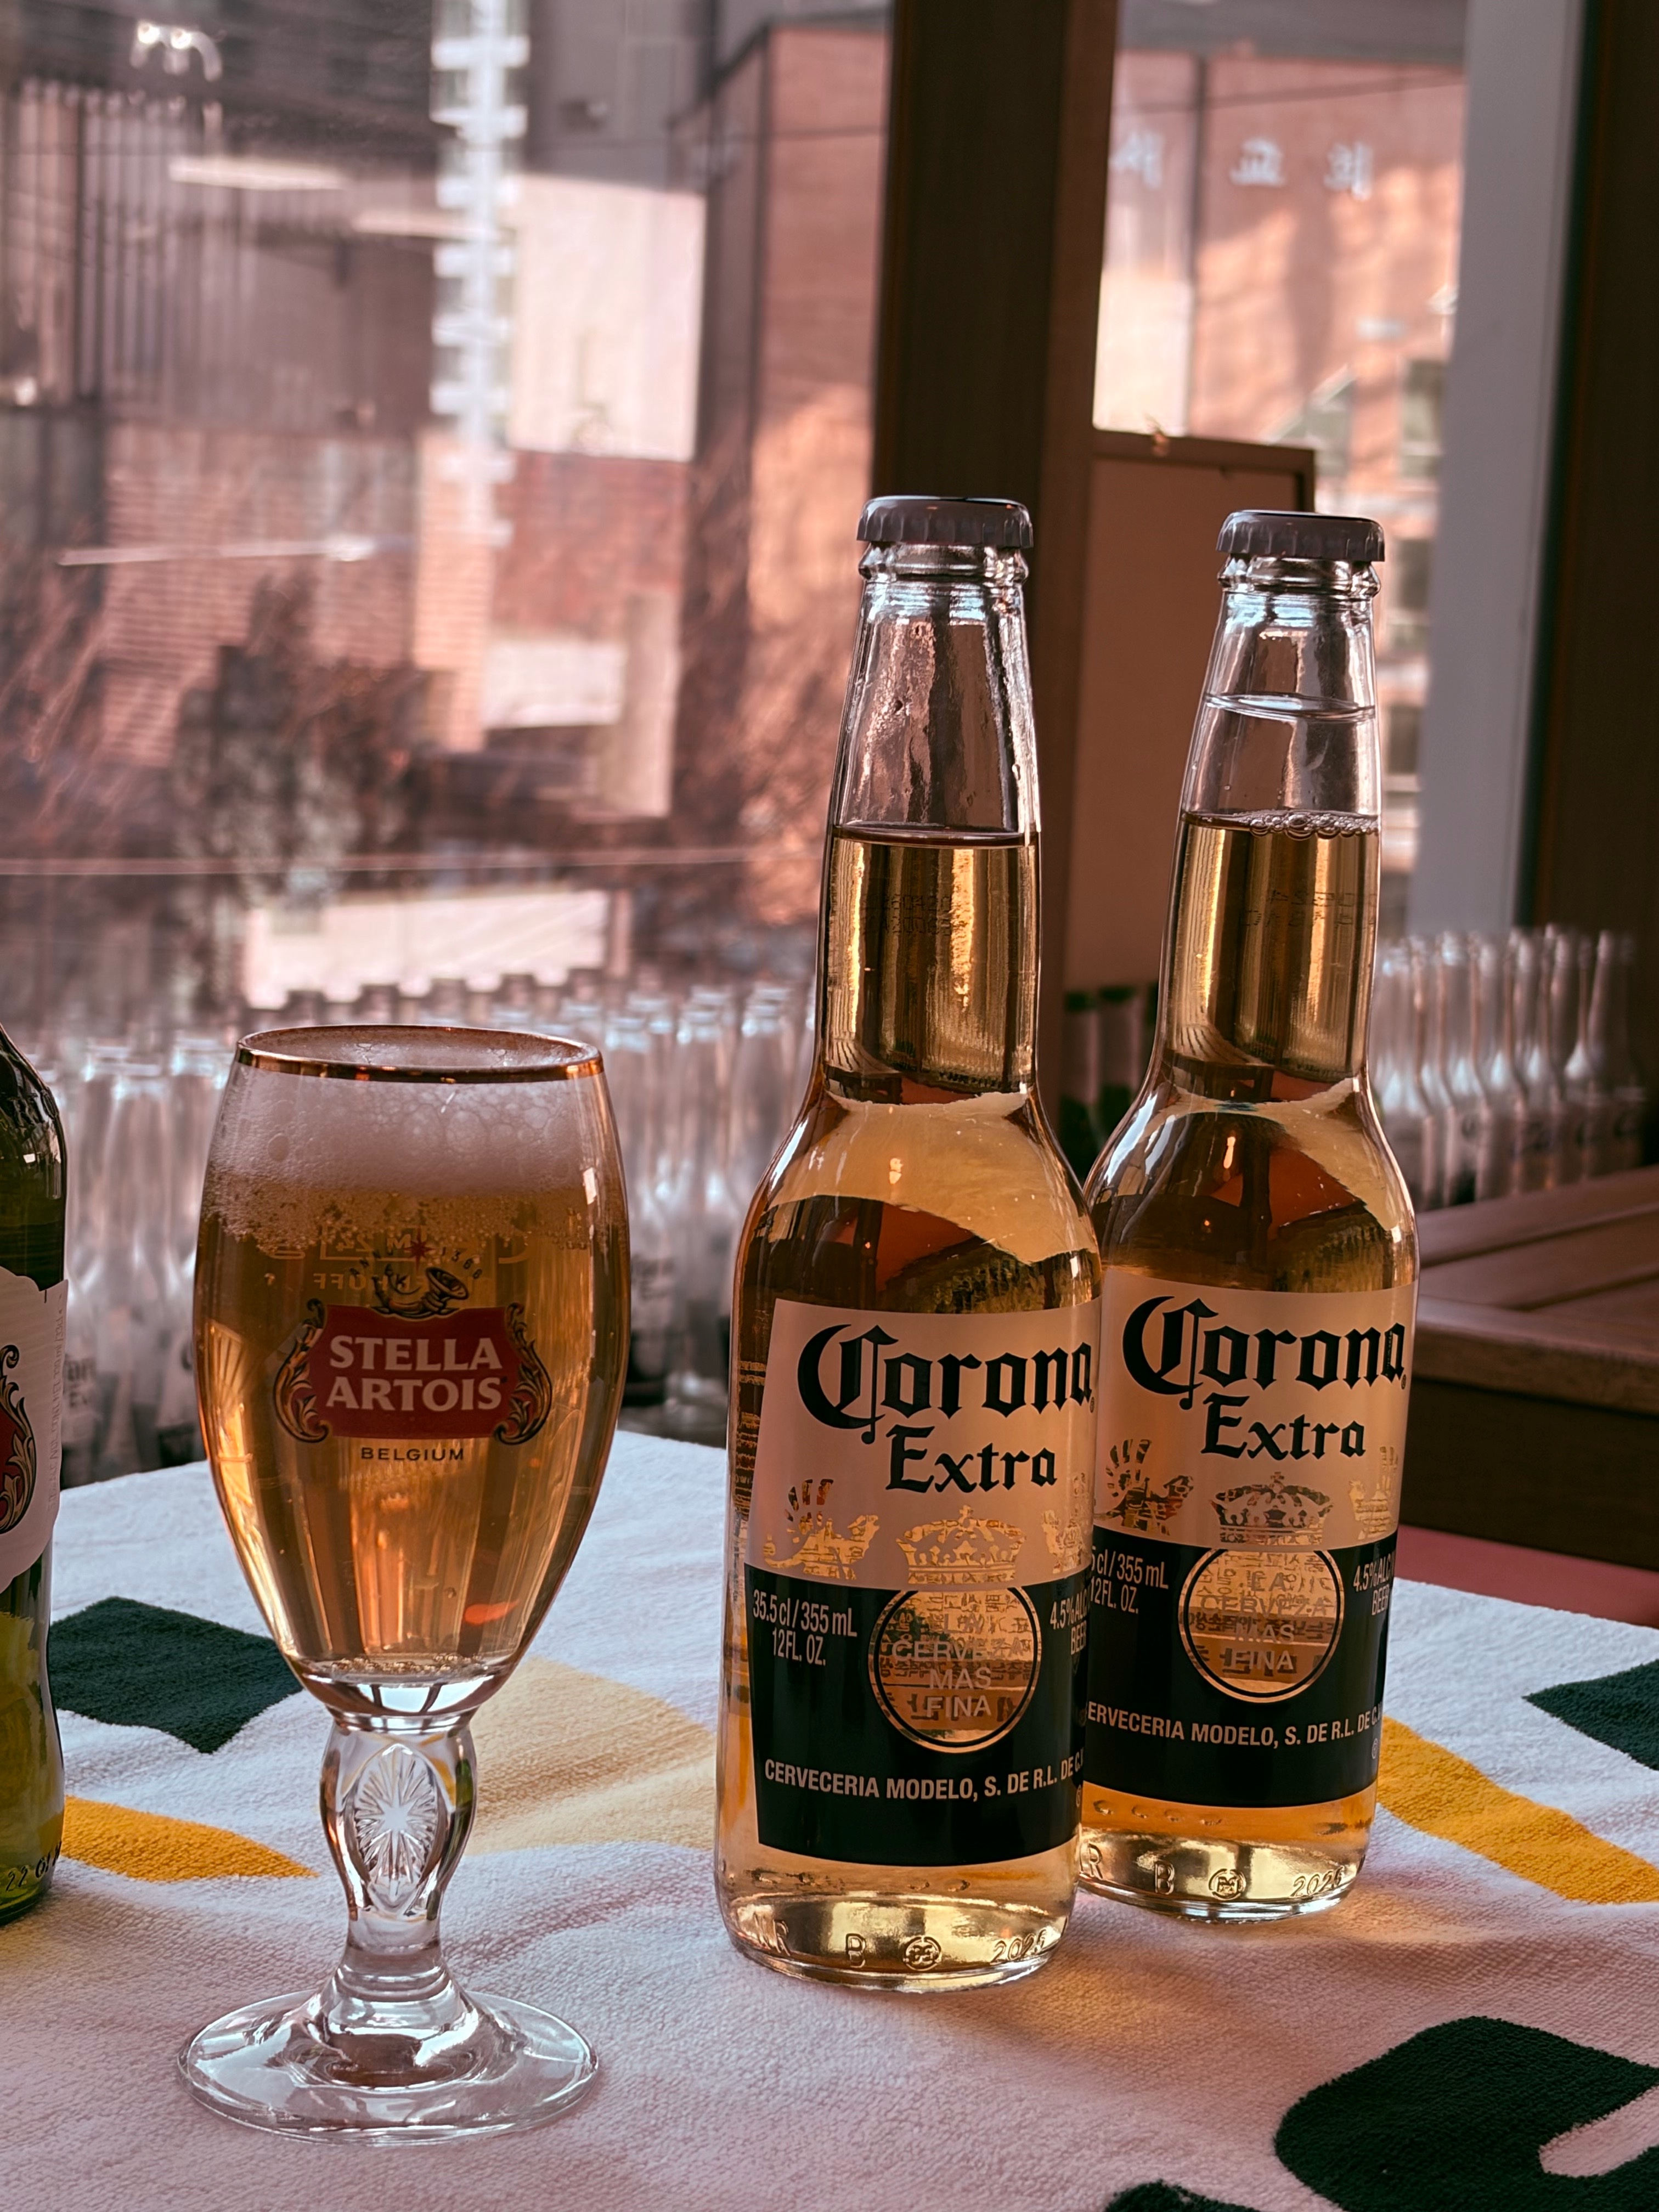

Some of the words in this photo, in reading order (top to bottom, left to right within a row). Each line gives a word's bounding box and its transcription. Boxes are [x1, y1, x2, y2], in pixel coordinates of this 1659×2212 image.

[329, 1335, 503, 1372] STELLA
[1122, 1295, 1405, 1410] Corona
[326, 1376, 502, 1412] ARTOIS
[797, 1323, 1093, 1444] Corona
[1200, 1392, 1366, 1462] Extra
[360, 1446, 465, 1462] BELGIUM
[885, 1423, 1057, 1493] Extra
[1120, 1583, 1139, 1614] OZ.
[1200, 1595, 1327, 1618] CERVEZA
[891, 1637, 1024, 1662] CERVEZA
[1235, 1622, 1295, 1643] MAS
[806, 1633, 827, 1667] OZ.
[1232, 1650, 1294, 1671] FINA
[929, 1666, 991, 1690] MAS
[926, 1695, 991, 1718] FINA
[1087, 1702, 1185, 1740] ERVECERIA
[1191, 1723, 1279, 1749] MODELO,
[1285, 1727, 1301, 1746] S.
[1307, 1723, 1327, 1745] DE
[1331, 1718, 1355, 1740] R.L.
[1357, 1711, 1371, 1733] DE
[764, 1758, 879, 1798] CERVECERIA
[886, 1777, 978, 1803] MODELO,
[985, 1775, 1001, 1797] S.
[1007, 1770, 1029, 1795] DE
[1033, 1765, 1058, 1790] R.L.
[1060, 1756, 1074, 1780] DE
